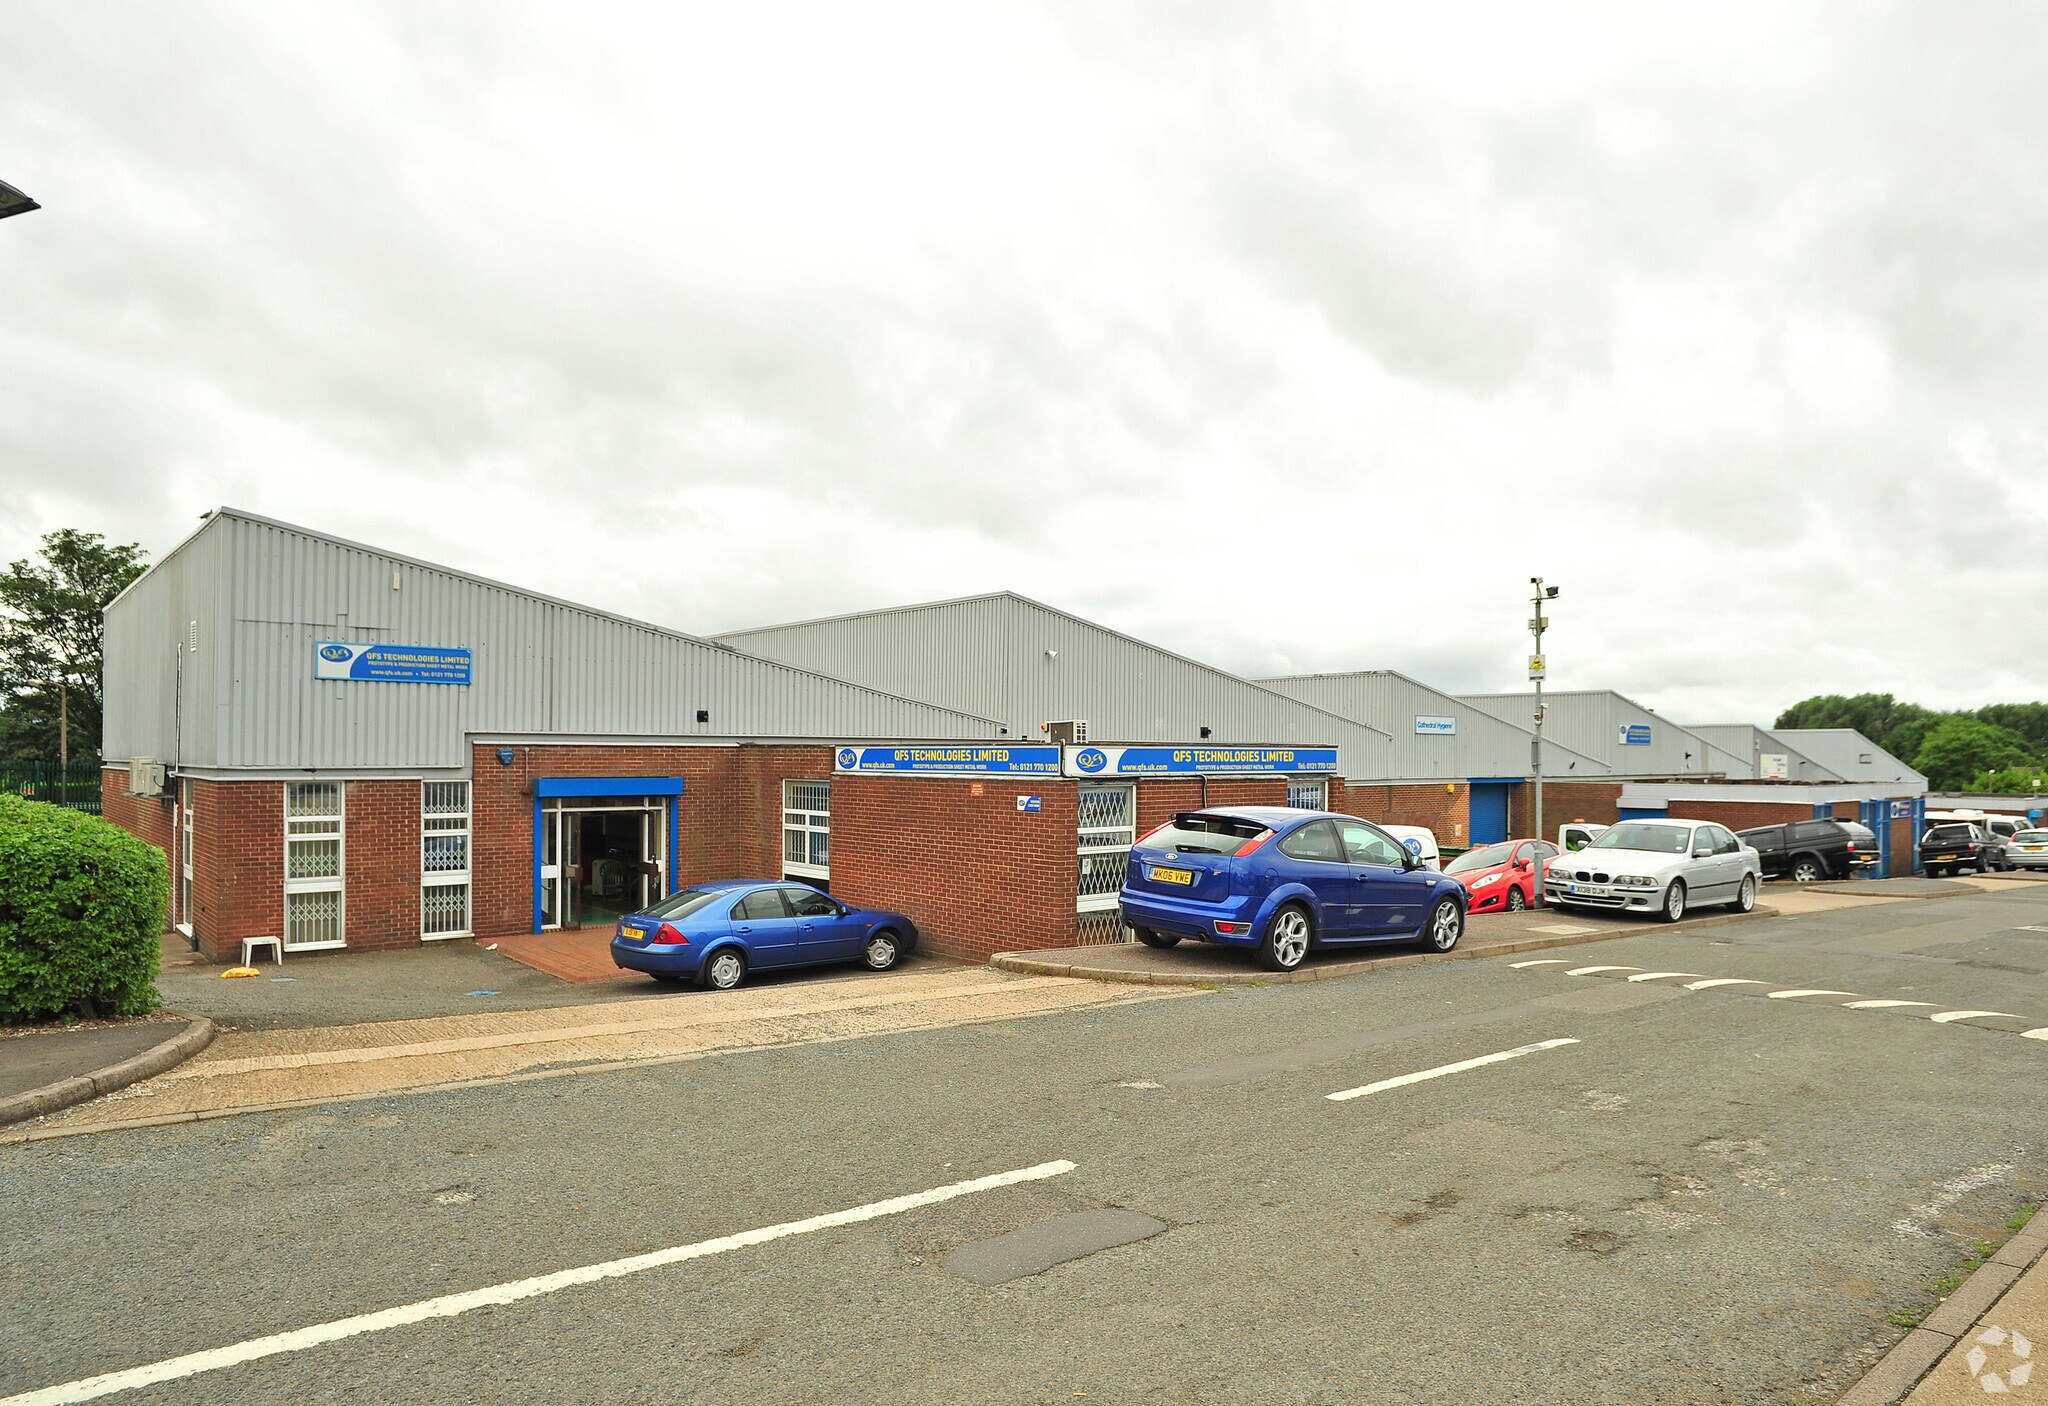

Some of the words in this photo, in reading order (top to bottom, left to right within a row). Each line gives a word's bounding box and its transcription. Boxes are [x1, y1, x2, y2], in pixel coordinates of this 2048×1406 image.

[366, 652, 381, 661] QFS
[383, 653, 439, 663] TECHNOLOGIES
[440, 656, 470, 664] LIMITED
[894, 750, 909, 761] QFS
[911, 750, 971, 762] TECHNOLOGIES
[973, 750, 1010, 762] LIMITED
[1173, 750, 1192, 762] QFS
[1194, 750, 1260, 762] TECHNOLOGIES
[1262, 751, 1294, 762] LIMITED
[1009, 762, 1019, 771] Tel:
[1020, 763, 1032, 771] 0121
[1034, 763, 1044, 771] 770
[1045, 763, 1058, 772] 1200
[1122, 763, 1168, 772] www.qfs.uk.com
